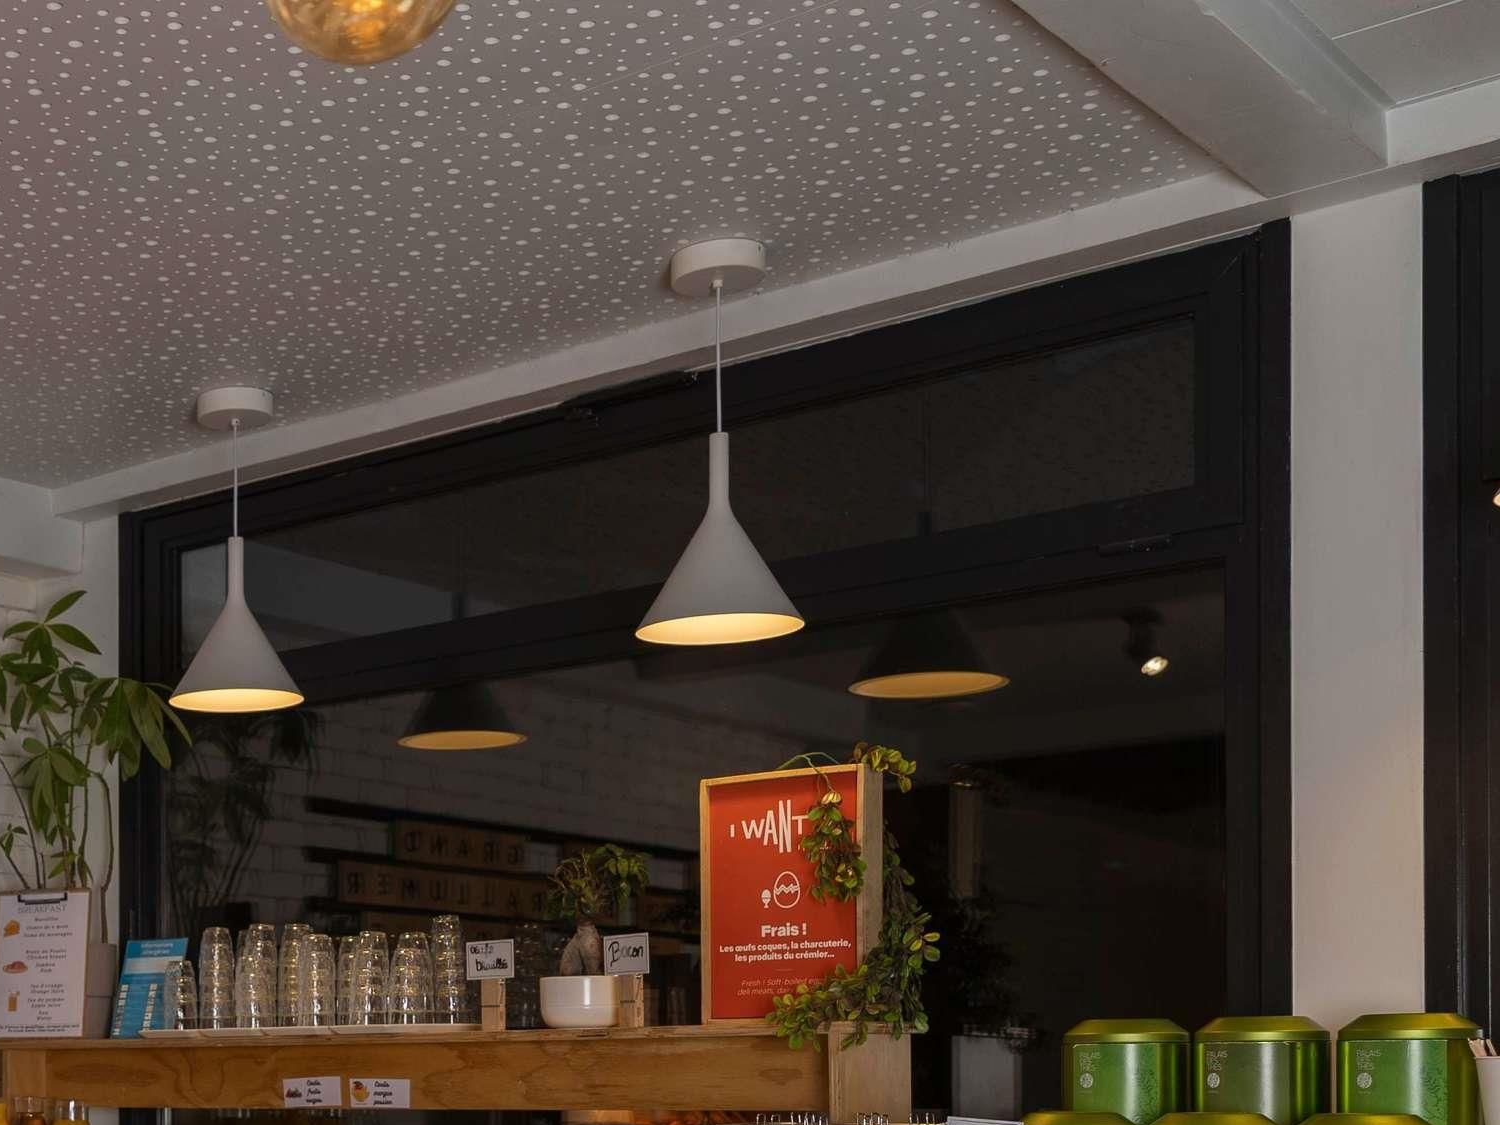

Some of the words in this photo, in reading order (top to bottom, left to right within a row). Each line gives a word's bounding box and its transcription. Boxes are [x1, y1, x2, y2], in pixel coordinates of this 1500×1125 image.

[741, 799, 809, 853] WANT
[761, 922, 799, 938] Frais
[802, 922, 807, 936] !
[719, 945, 734, 953] Les
[757, 942, 790, 952] coques,
[791, 941, 799, 949] la
[800, 938, 852, 949] charcuterie,
[608, 941, 644, 967] Bacon
[735, 954, 748, 962] les
[748, 951, 782, 963] produits
[783, 951, 794, 960] du
